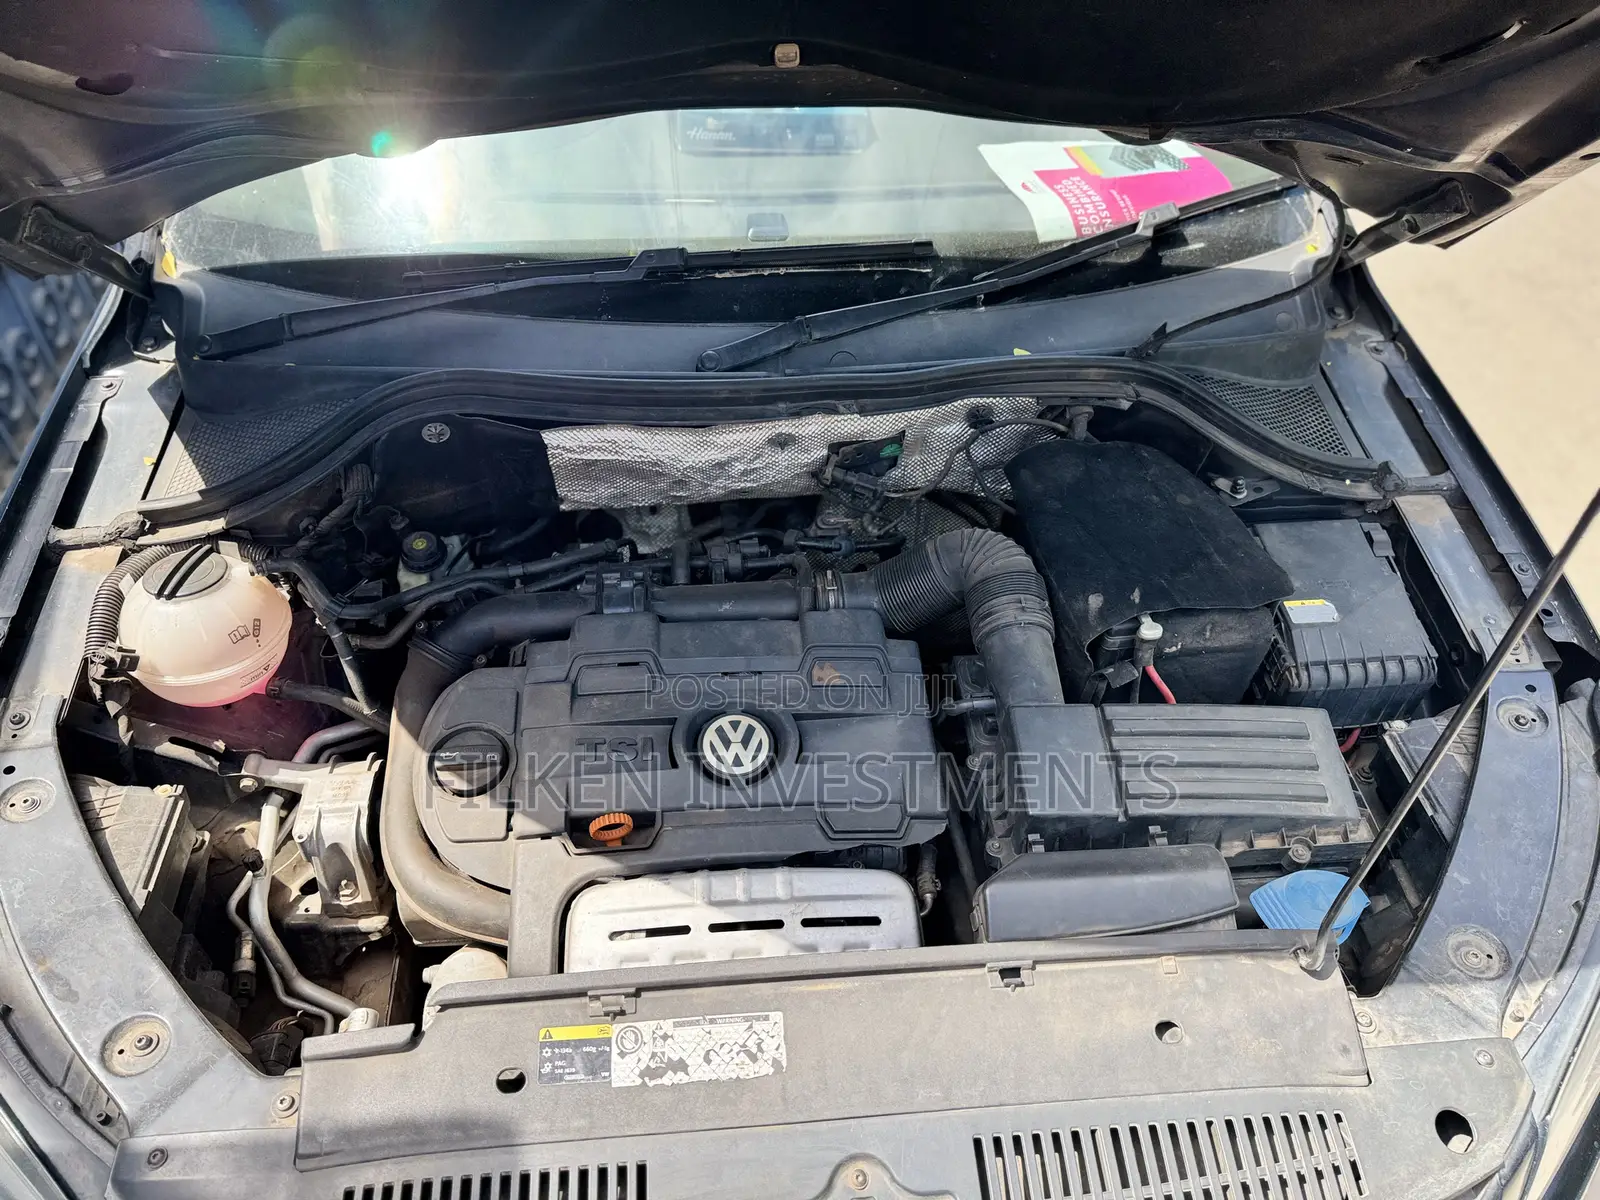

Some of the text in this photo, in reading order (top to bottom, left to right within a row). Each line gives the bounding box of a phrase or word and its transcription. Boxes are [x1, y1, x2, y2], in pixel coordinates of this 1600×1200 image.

[1053, 183, 1092, 235] BUSINESS
[1069, 176, 1113, 228] NSURANCE
[575, 736, 655, 762] TSI
